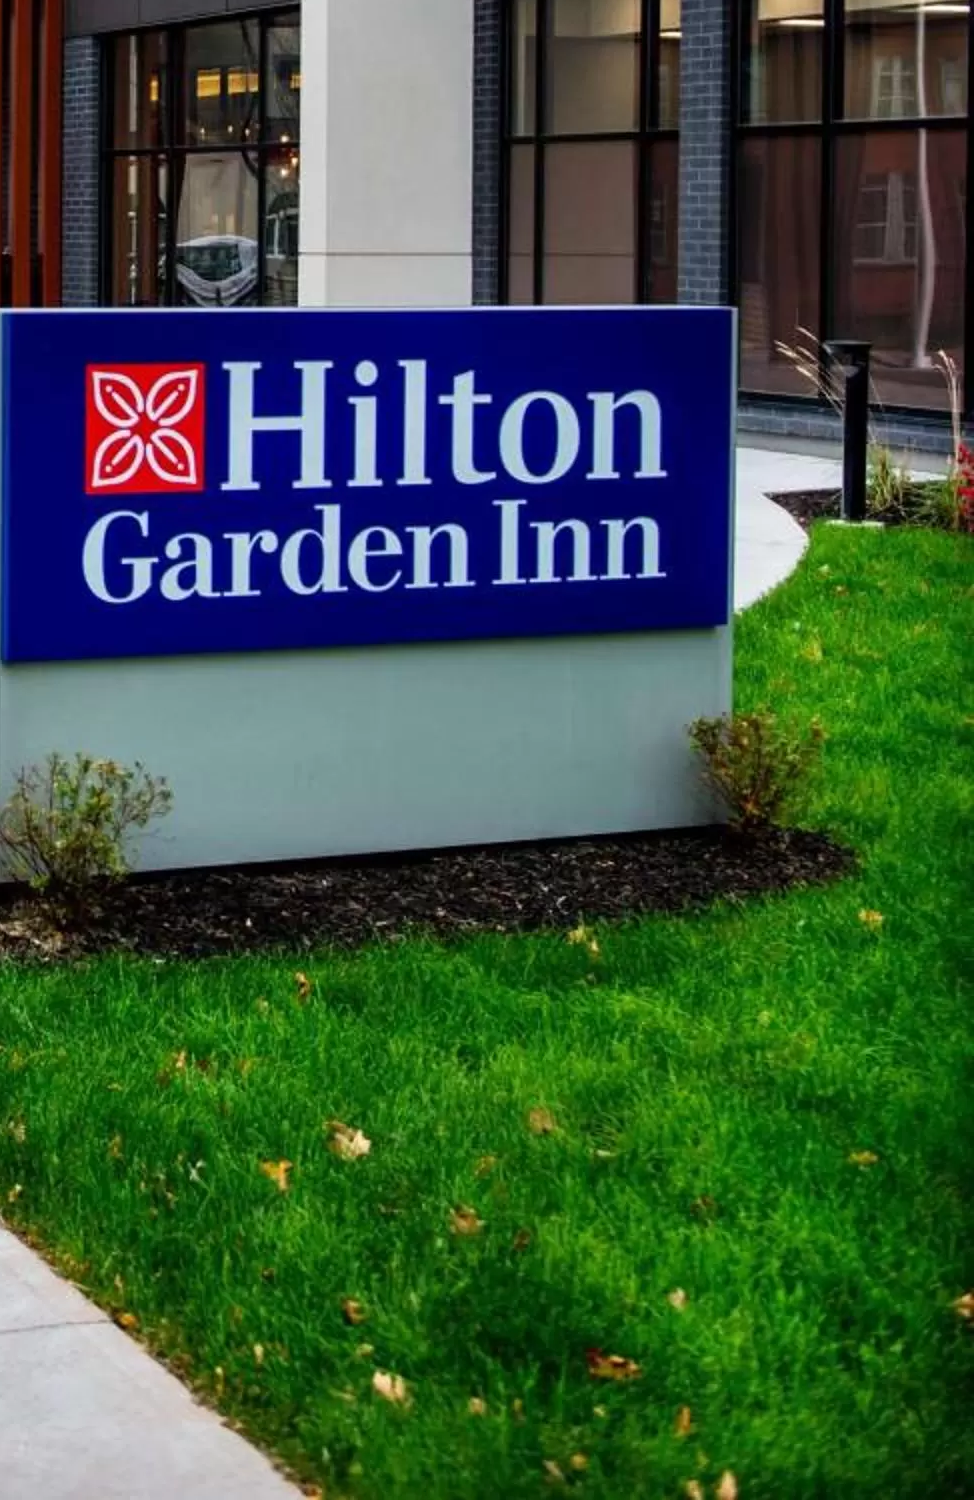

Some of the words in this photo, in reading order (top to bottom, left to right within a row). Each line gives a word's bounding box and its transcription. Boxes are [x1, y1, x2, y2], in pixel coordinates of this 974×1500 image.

[220, 359, 667, 491] Hilton
[82, 504, 475, 603] Garden
[491, 500, 667, 584] Inn
